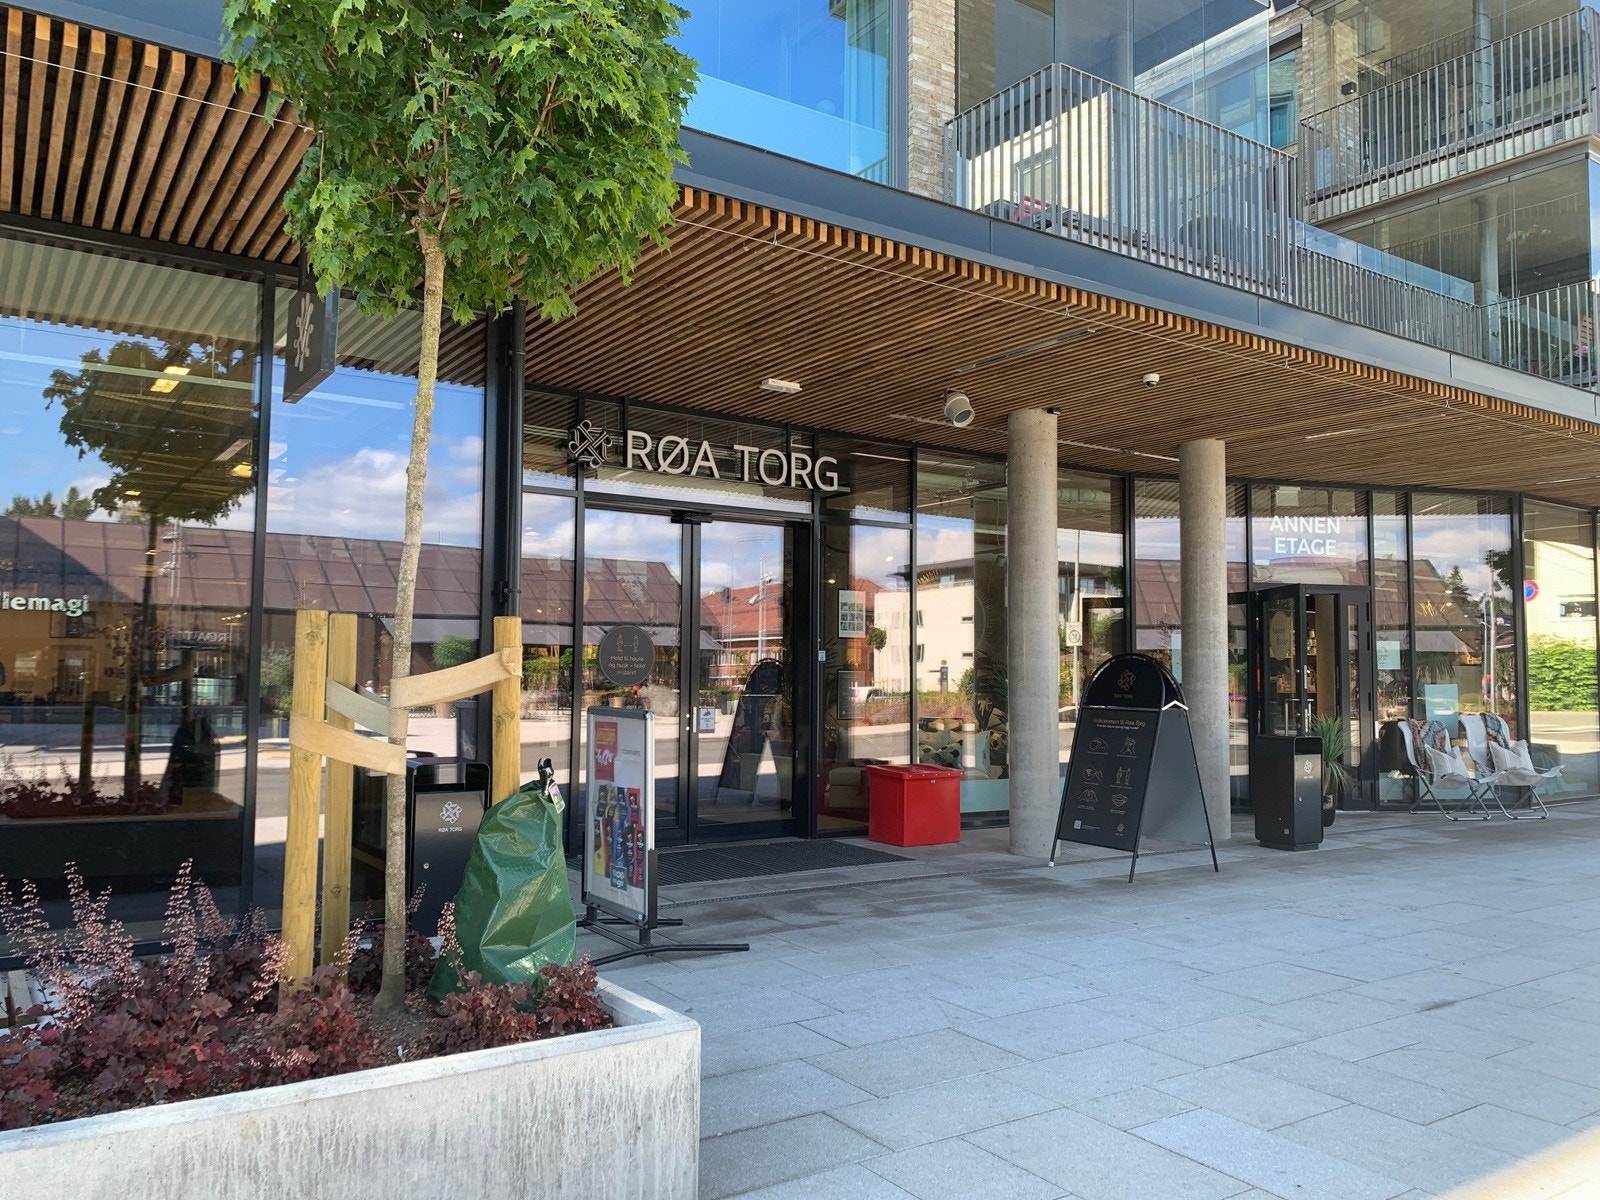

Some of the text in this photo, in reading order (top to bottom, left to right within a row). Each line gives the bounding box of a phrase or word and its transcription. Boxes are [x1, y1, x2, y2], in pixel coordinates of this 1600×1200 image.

[627, 429, 839, 491] RØA TORG
[1269, 515, 1341, 535] ANNEN
[1275, 536, 1337, 556] ETAGE
[0, 591, 90, 617] lemagi
